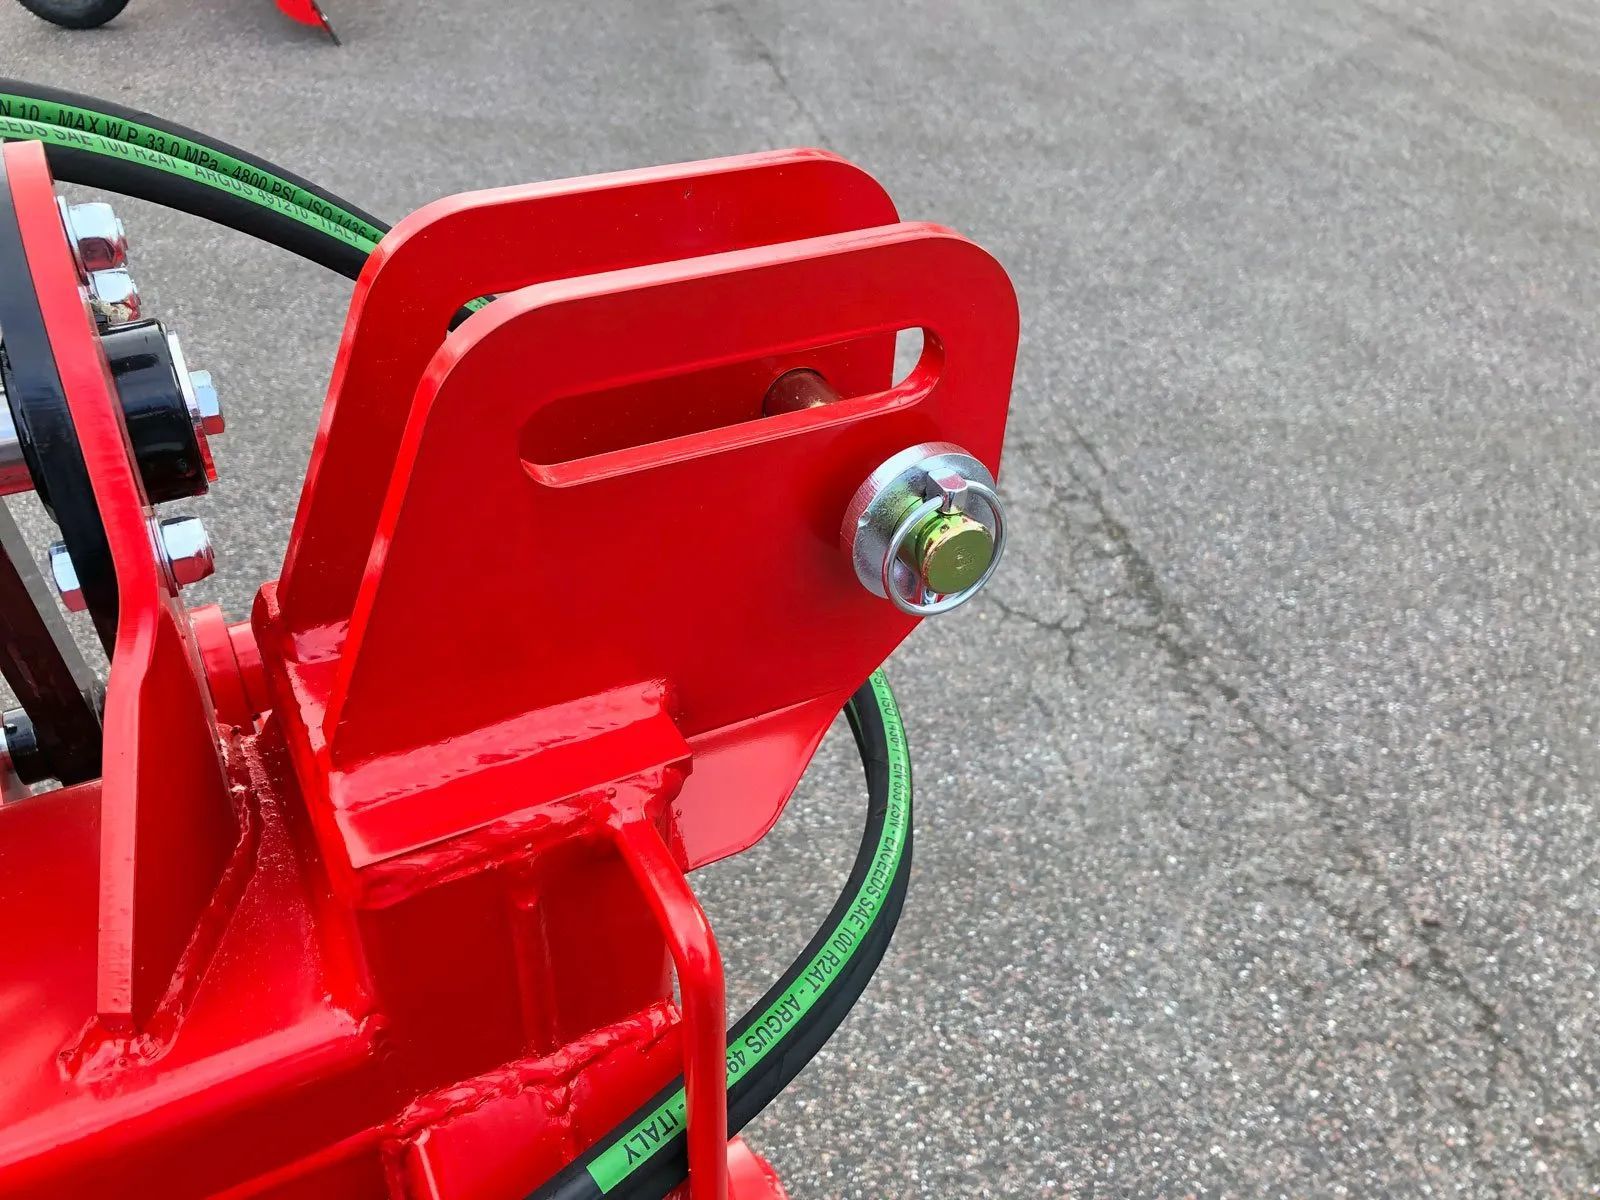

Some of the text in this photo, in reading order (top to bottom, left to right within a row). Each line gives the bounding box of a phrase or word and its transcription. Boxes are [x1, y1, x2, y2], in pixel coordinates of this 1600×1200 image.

[19, 103, 40, 121] 10
[59, 110, 99, 134] MAX
[145, 134, 180, 157] 33.0
[184, 146, 218, 171] MPa
[231, 166, 267, 190] 4800
[271, 181, 296, 203] PSI
[308, 199, 333, 219] ISO
[194, 166, 253, 196] ARGUS
[866, 837, 898, 899] EXCEEDS
[849, 897, 875, 930] SAE
[833, 927, 857, 954] 100
[804, 950, 840, 993] R2AT
[745, 994, 801, 1054] ARGUS
[726, 1050, 746, 1081] 49
[623, 1109, 679, 1165] ITALY
